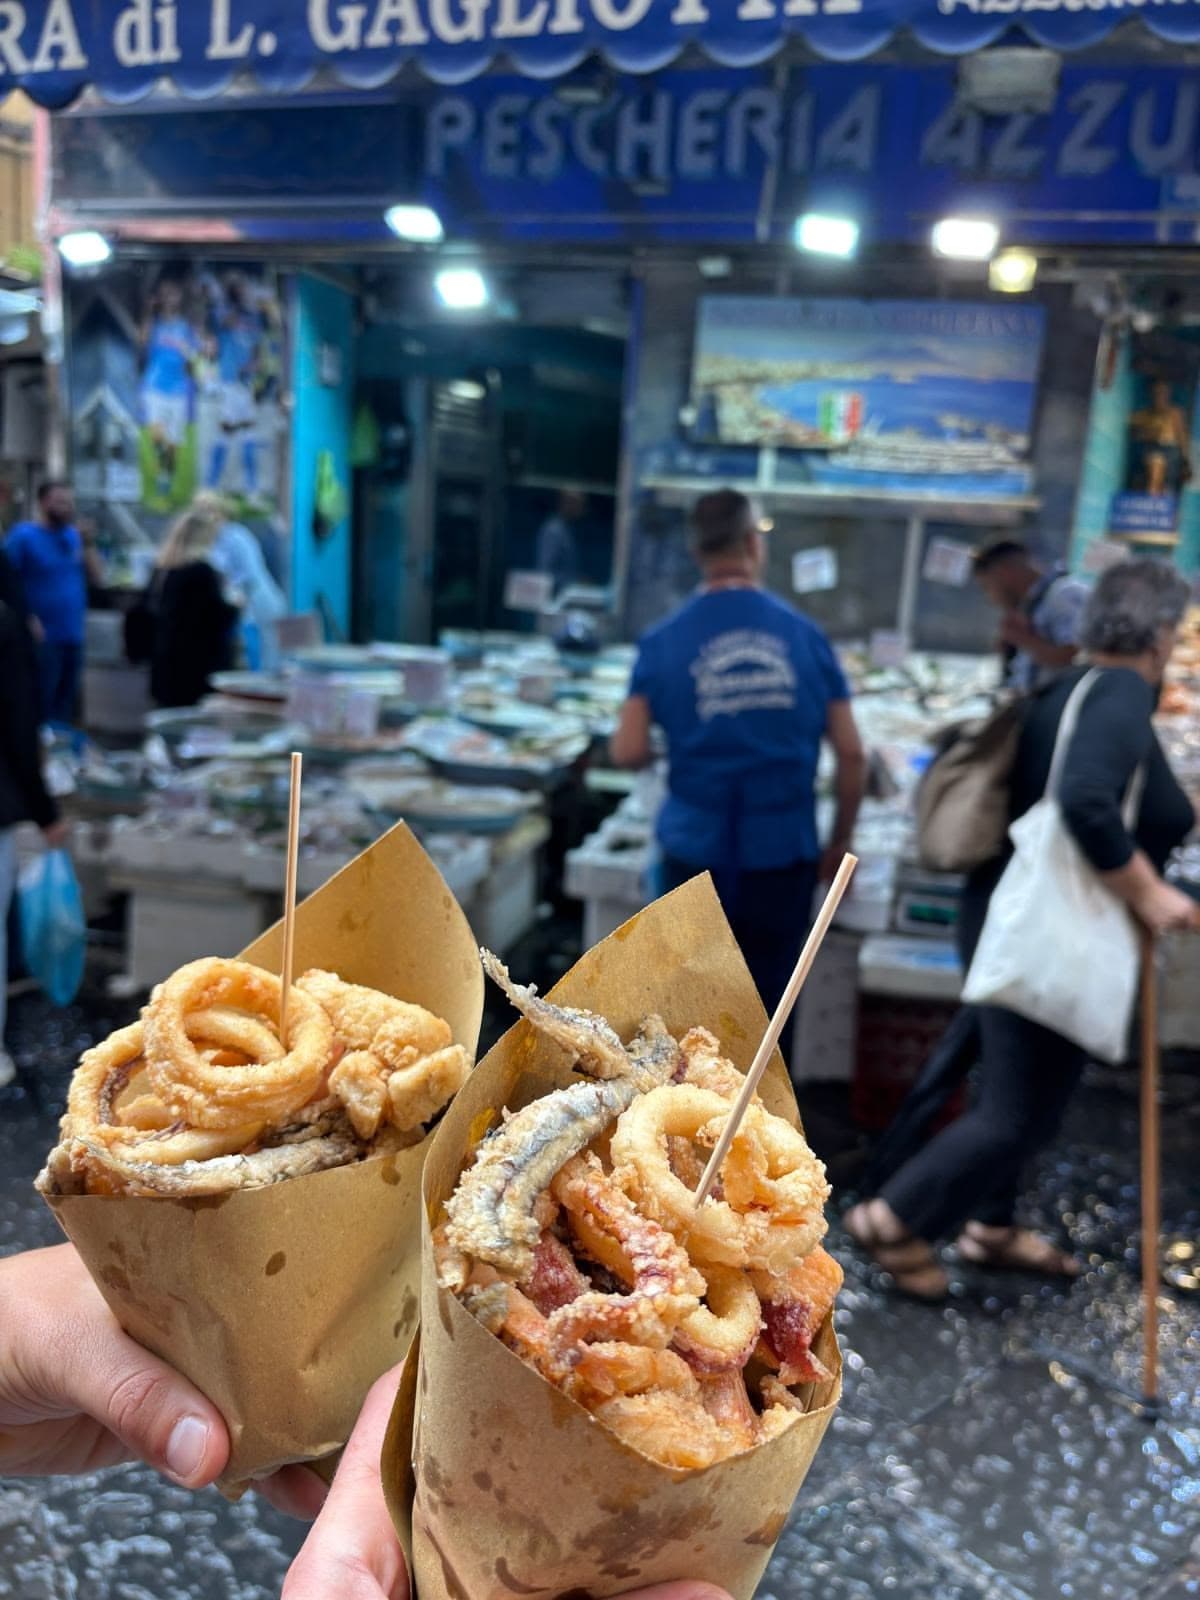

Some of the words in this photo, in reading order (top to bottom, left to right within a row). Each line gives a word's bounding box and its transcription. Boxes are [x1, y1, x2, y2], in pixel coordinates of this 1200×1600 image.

[113, 0, 181, 67] di
[205, 0, 276, 60] L.
[308, 0, 862, 52] GAGLIO
[424, 82, 880, 181] PESCHERIA
